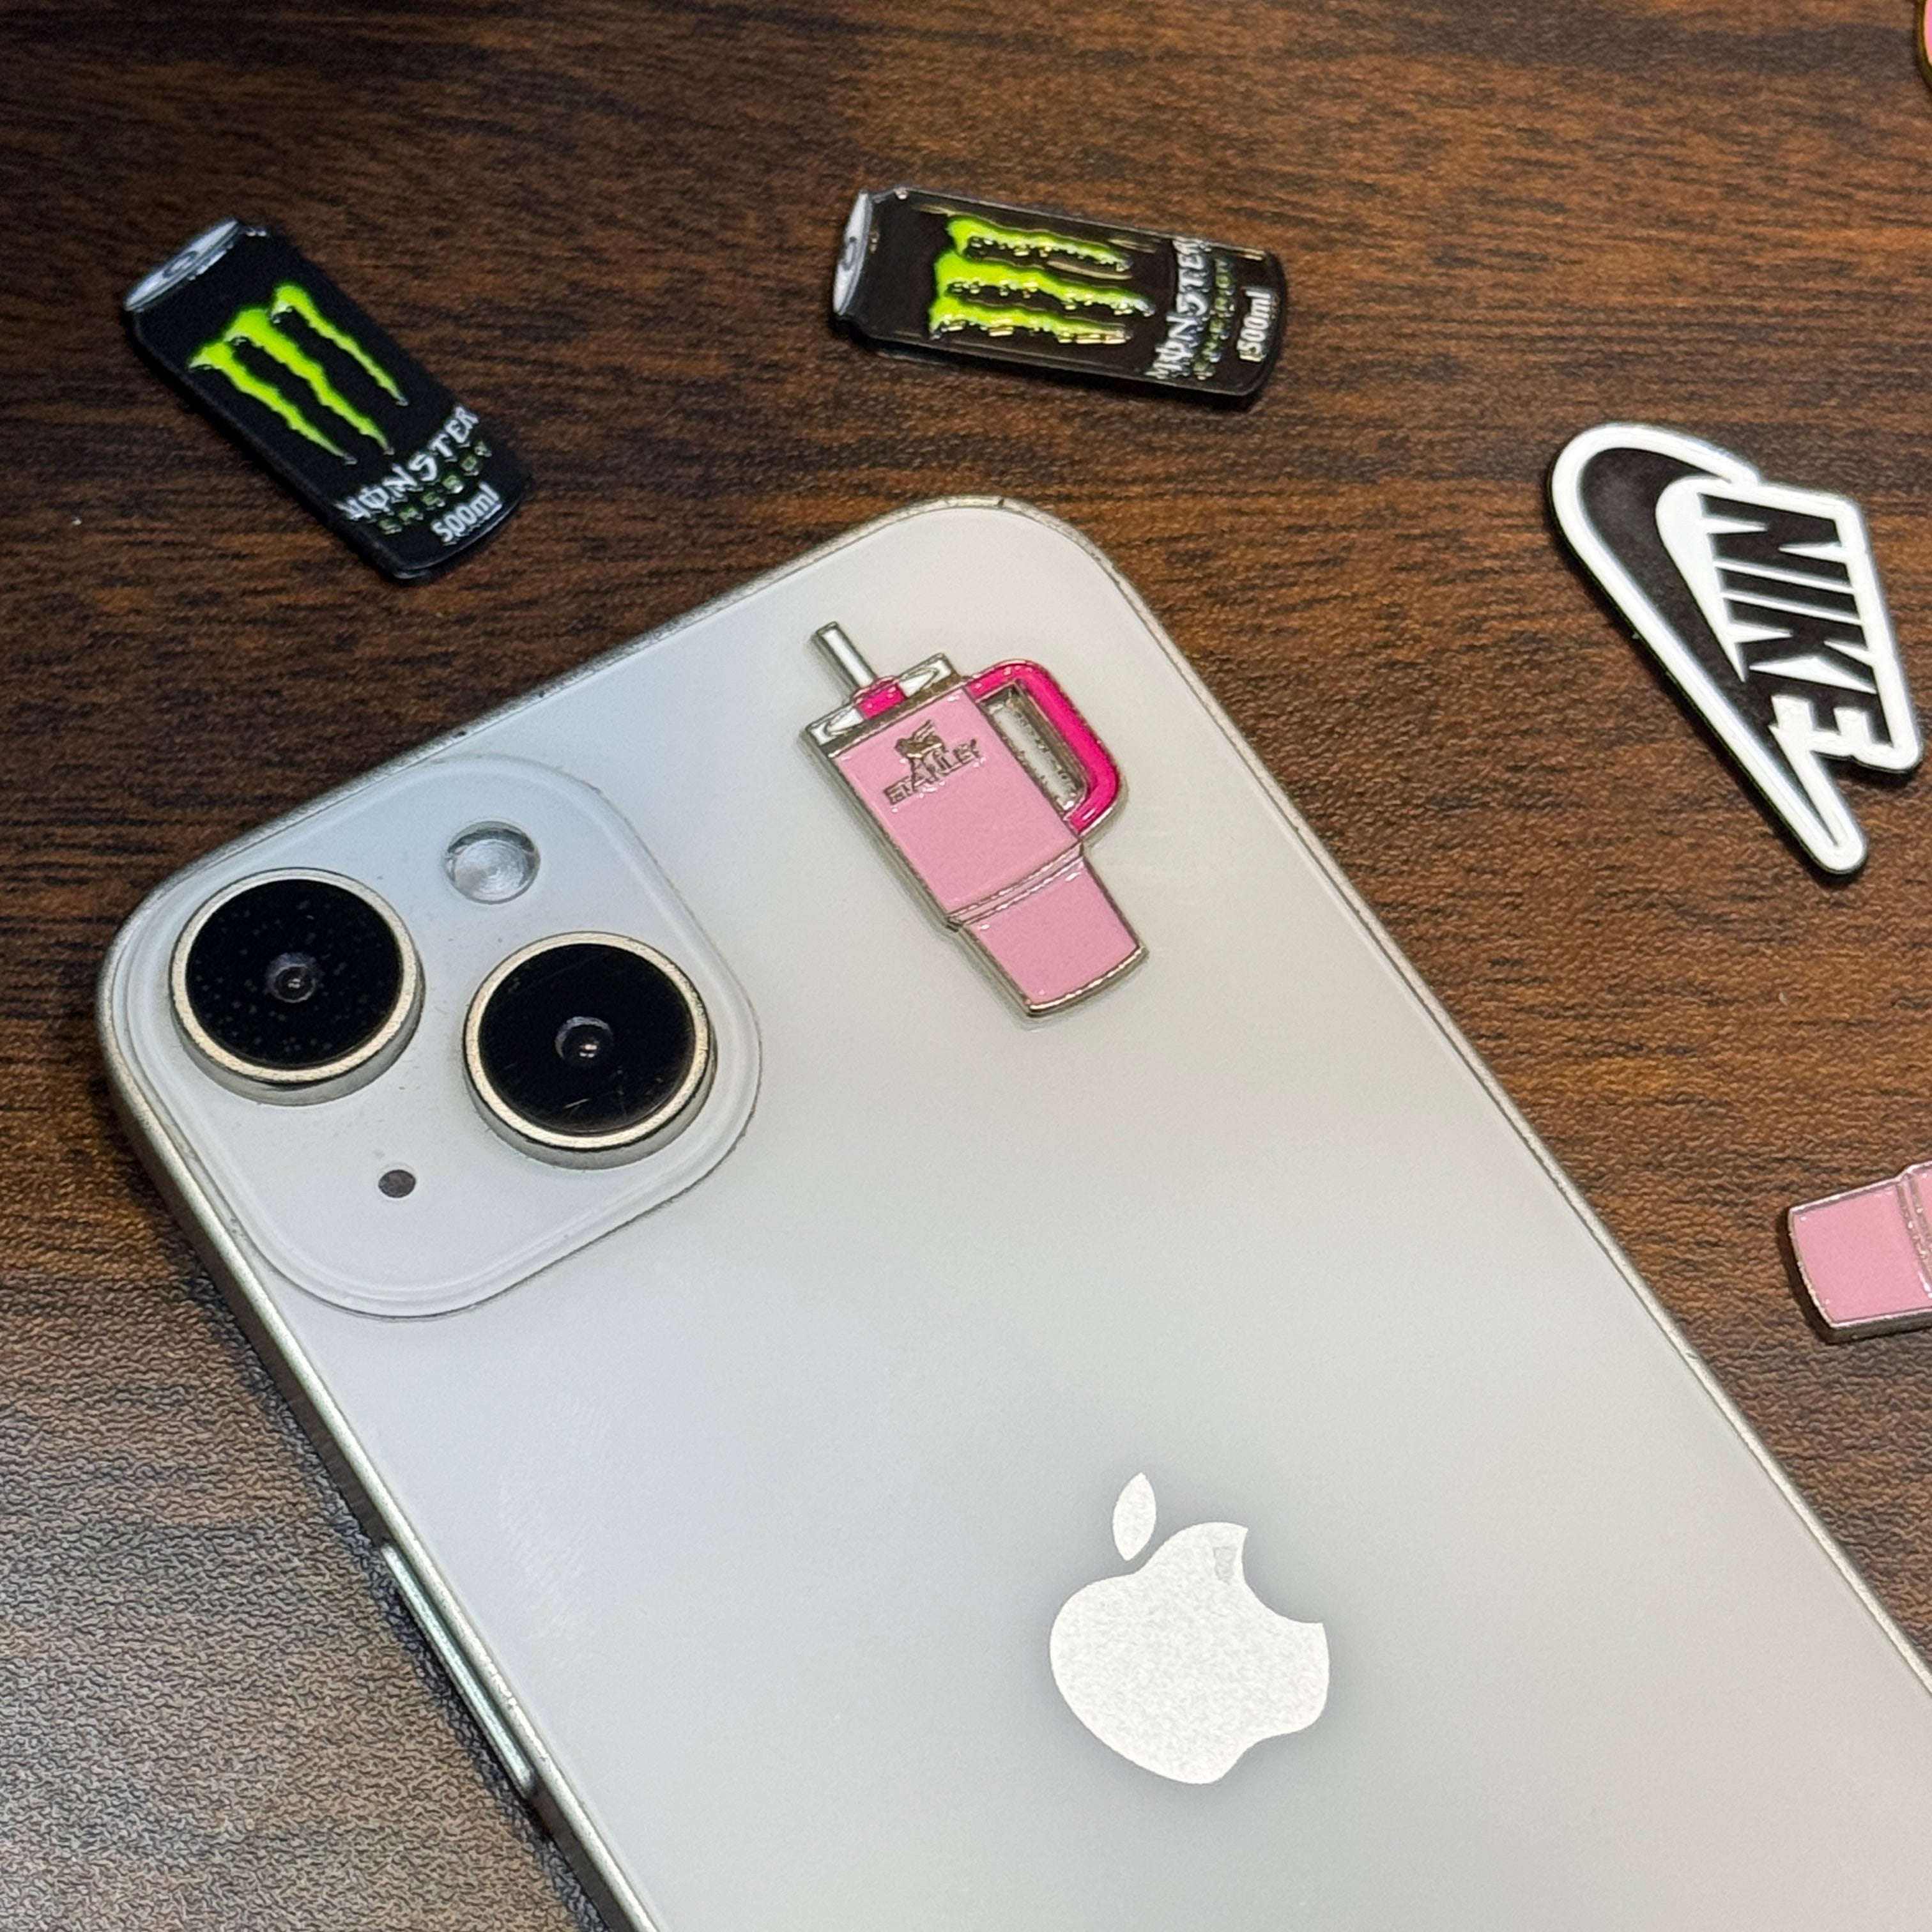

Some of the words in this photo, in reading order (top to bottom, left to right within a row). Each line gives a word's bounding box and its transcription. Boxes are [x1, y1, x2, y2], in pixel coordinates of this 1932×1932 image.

[1144, 236, 1210, 379] MONSTER
[1237, 289, 1271, 358] 500ml
[333, 404, 479, 521] MONSTER
[431, 482, 503, 543] 500ml
[1698, 492, 1894, 749] NIKE
